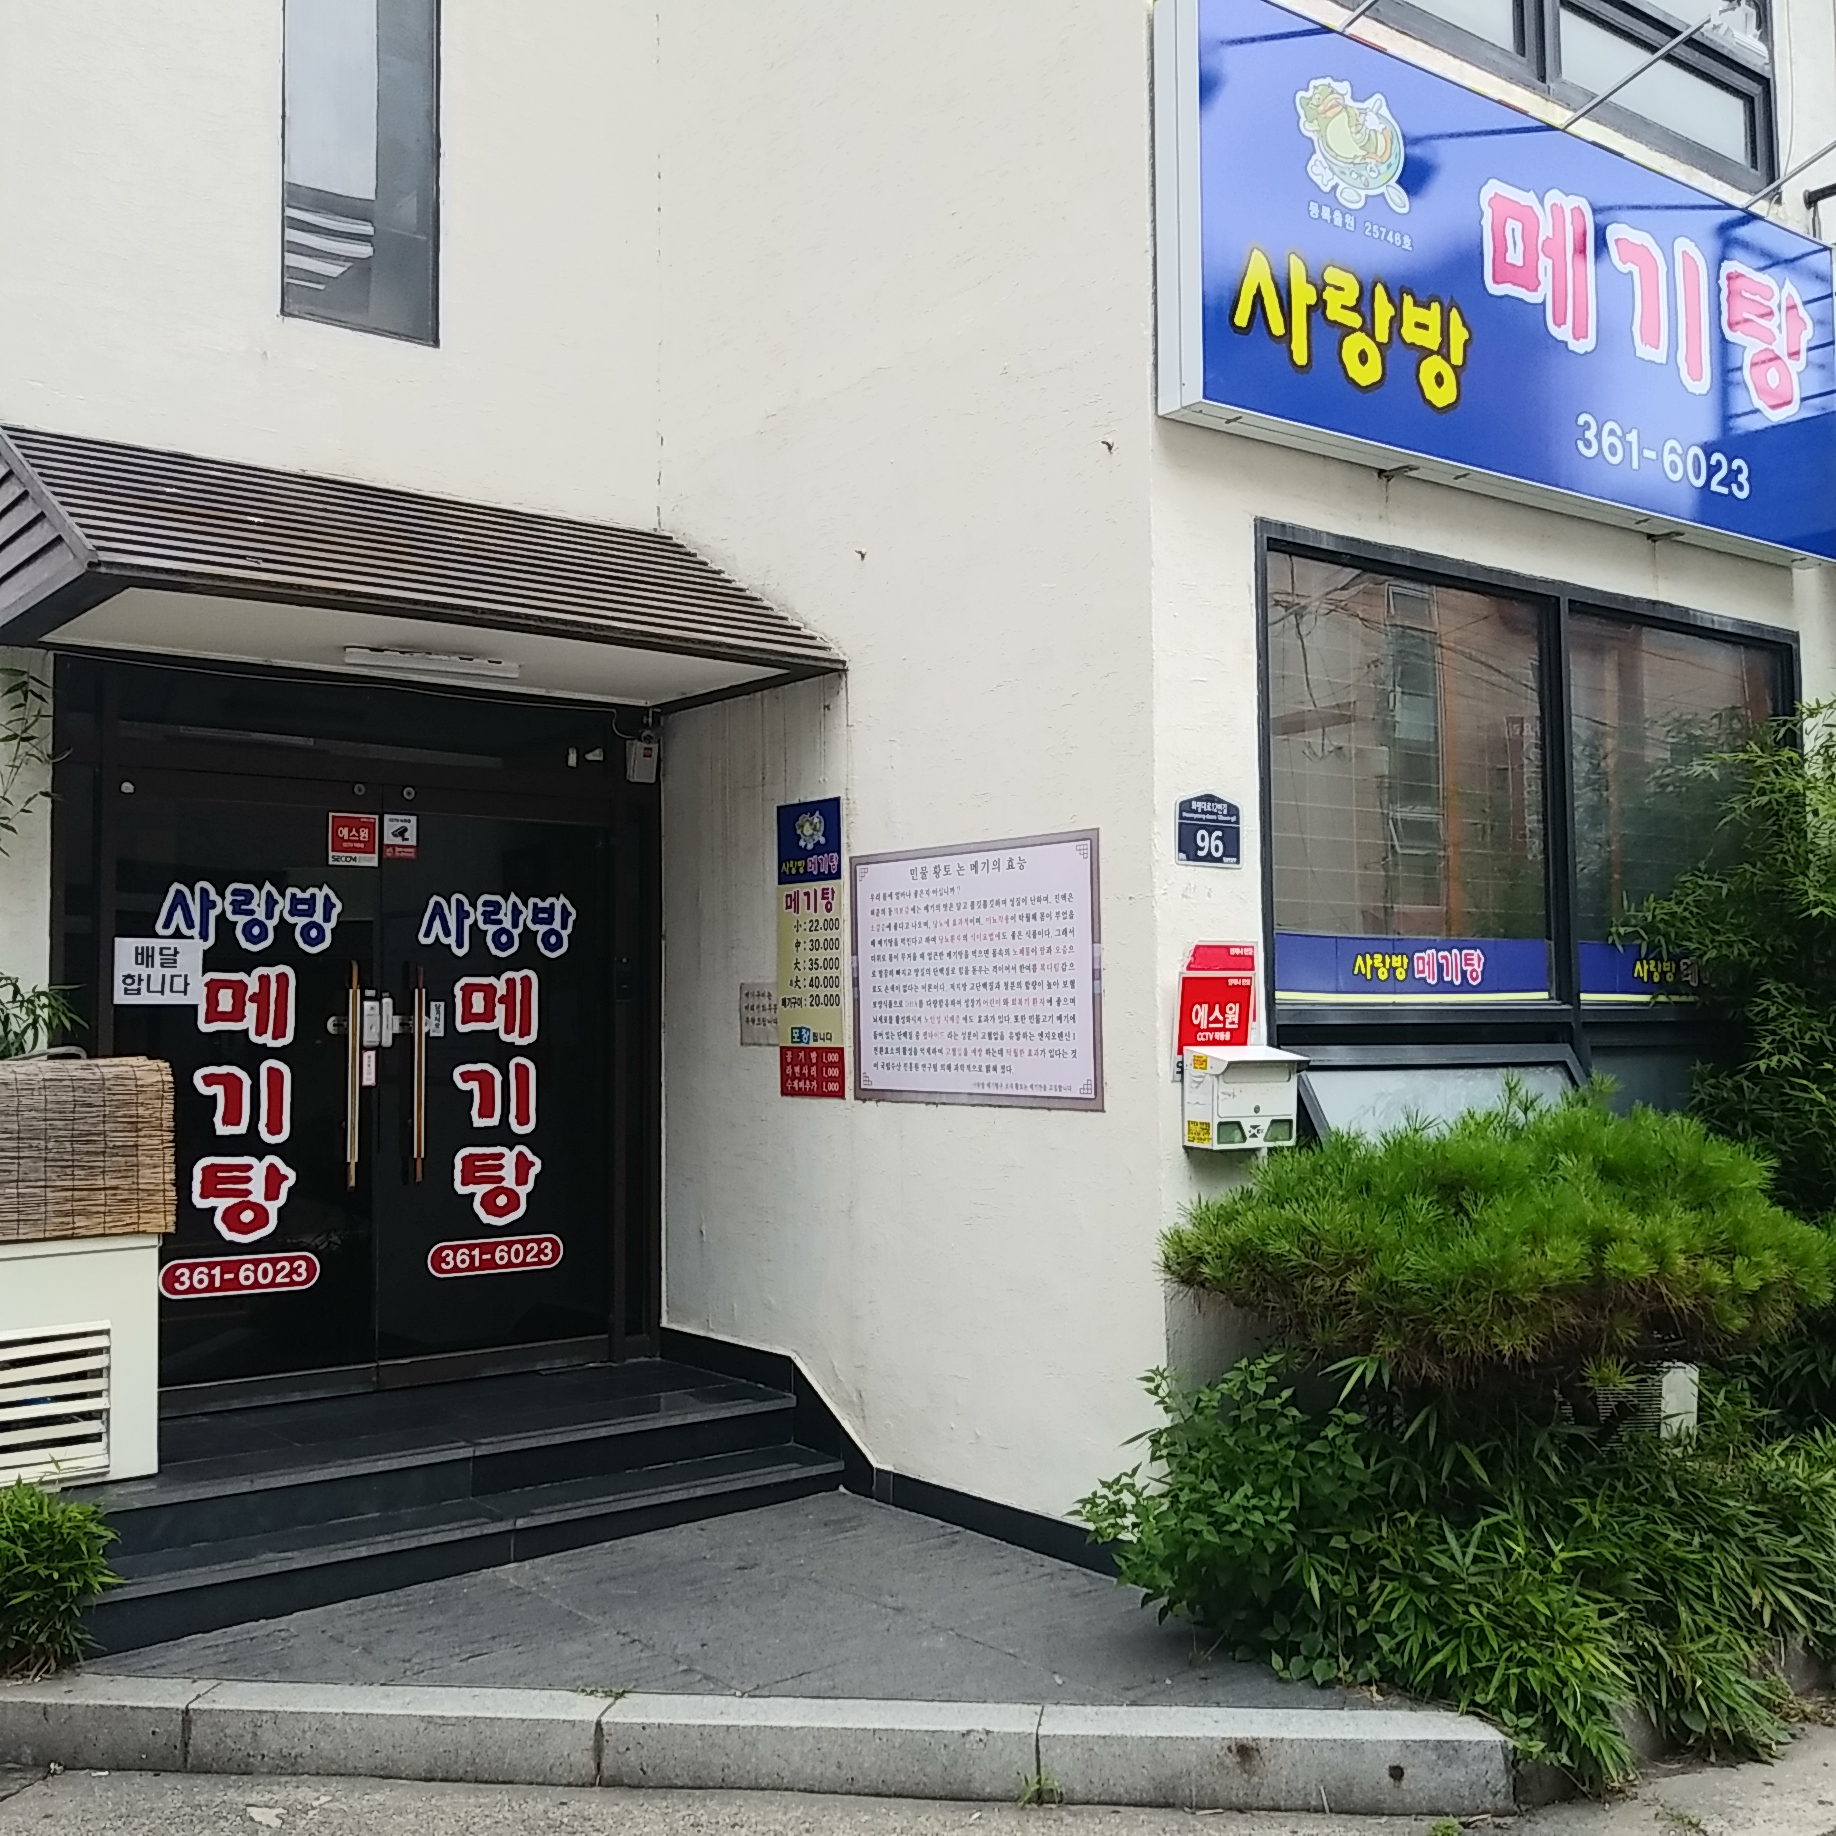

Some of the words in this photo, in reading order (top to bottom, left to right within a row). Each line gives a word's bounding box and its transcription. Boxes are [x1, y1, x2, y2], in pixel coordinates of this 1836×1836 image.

[1364, 221, 1413, 252] 25746호
[1481, 178, 1813, 421] 메기탕
[1234, 247, 1470, 409] 사랑방
[1577, 413, 1751, 500] 361-6023
[338, 826, 368, 841] 에스원
[1196, 830, 1224, 858] 96
[782, 860, 805, 874] 사랑방
[806, 852, 839, 875] 메기탕
[909, 865, 928, 881] 민물
[932, 862, 951, 879] 황토
[955, 861, 965, 877] 논
[969, 857, 1000, 875] 메기의
[1005, 854, 1027, 872] 효능
[784, 886, 836, 915] 메기탕
[869, 892, 880, 902] 우리
[155, 881, 342, 953] 사랑방
[418, 893, 576, 958] 사랑방
[1054, 926, 1074, 938] 그래서
[134, 944, 180, 970] 배달
[1353, 952, 1408, 980] 사랑방
[1413, 947, 1485, 988] 메기탕
[1634, 960, 1676, 982] 사랑방
[122, 974, 190, 997] 합니다
[1191, 1003, 1240, 1029] 에스원
[792, 1028, 810, 1044] 포장
[1196, 1032, 1214, 1041] CCTV
[822, 1052, 839, 1064] 1,000
[822, 1066, 840, 1078] 1,000
[454, 970, 542, 1224] 메기탕
[822, 1081, 840, 1092] 1,000
[192, 965, 296, 1242] 메기탕
[440, 1241, 554, 1270] 361-6023
[174, 1260, 308, 1290] 361-6023
